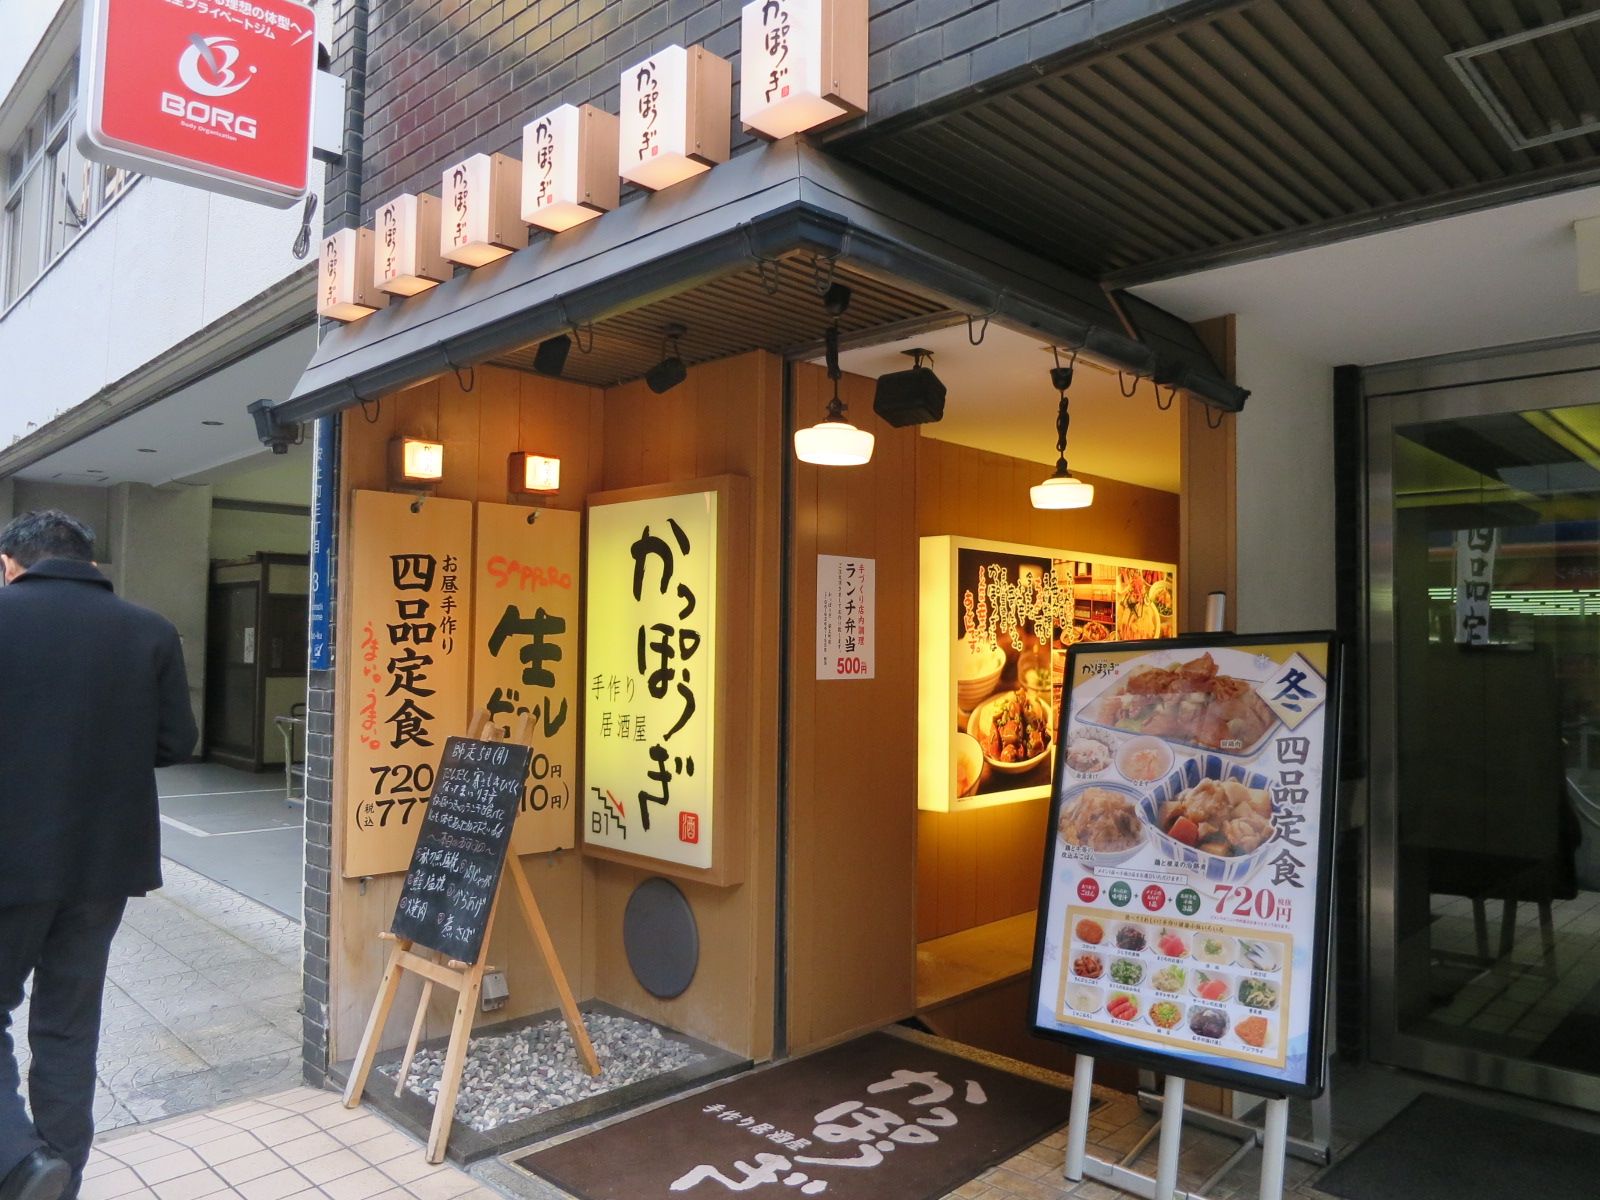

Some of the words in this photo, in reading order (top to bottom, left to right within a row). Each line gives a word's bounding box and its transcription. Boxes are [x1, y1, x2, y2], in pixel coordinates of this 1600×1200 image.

[762, 0, 790, 103] かっぽうぎ
[161, 91, 257, 140] BORG
[180, 120, 197, 131] Body
[636, 61, 659, 161] かっぽうぎ
[536, 117, 554, 207] かっぽうぎ
[453, 164, 468, 246] かっぽうぎ
[384, 205, 396, 279] かっぽうぎ
[326, 237, 338, 306] かっぽうぎ
[312, 572, 320, 592] 3
[439, 553, 460, 655] お昼手作り
[844, 563, 856, 653] ランチ弁当
[385, 553, 437, 749] 四品定食
[488, 604, 566, 688] 生
[591, 673, 636, 703] 手作り
[630, 518, 701, 832] かっぽうぎ
[1082, 663, 1119, 679] かっぽうぎ
[1271, 667, 1317, 713] 冬
[600, 711, 647, 743] 居酒屋
[369, 763, 435, 796] 720
[376, 796, 431, 827] 77
[592, 812, 609, 837] B1
[680, 813, 698, 841] 酒
[1267, 736, 1311, 888] 四品定食
[1080, 889, 1095, 897] ごはん
[1214, 884, 1275, 919] 720
[1276, 907, 1292, 922] 円
[670, 1069, 988, 1194] かっぽうぎ
[702, 1102, 812, 1151] 手作り居酒屋
